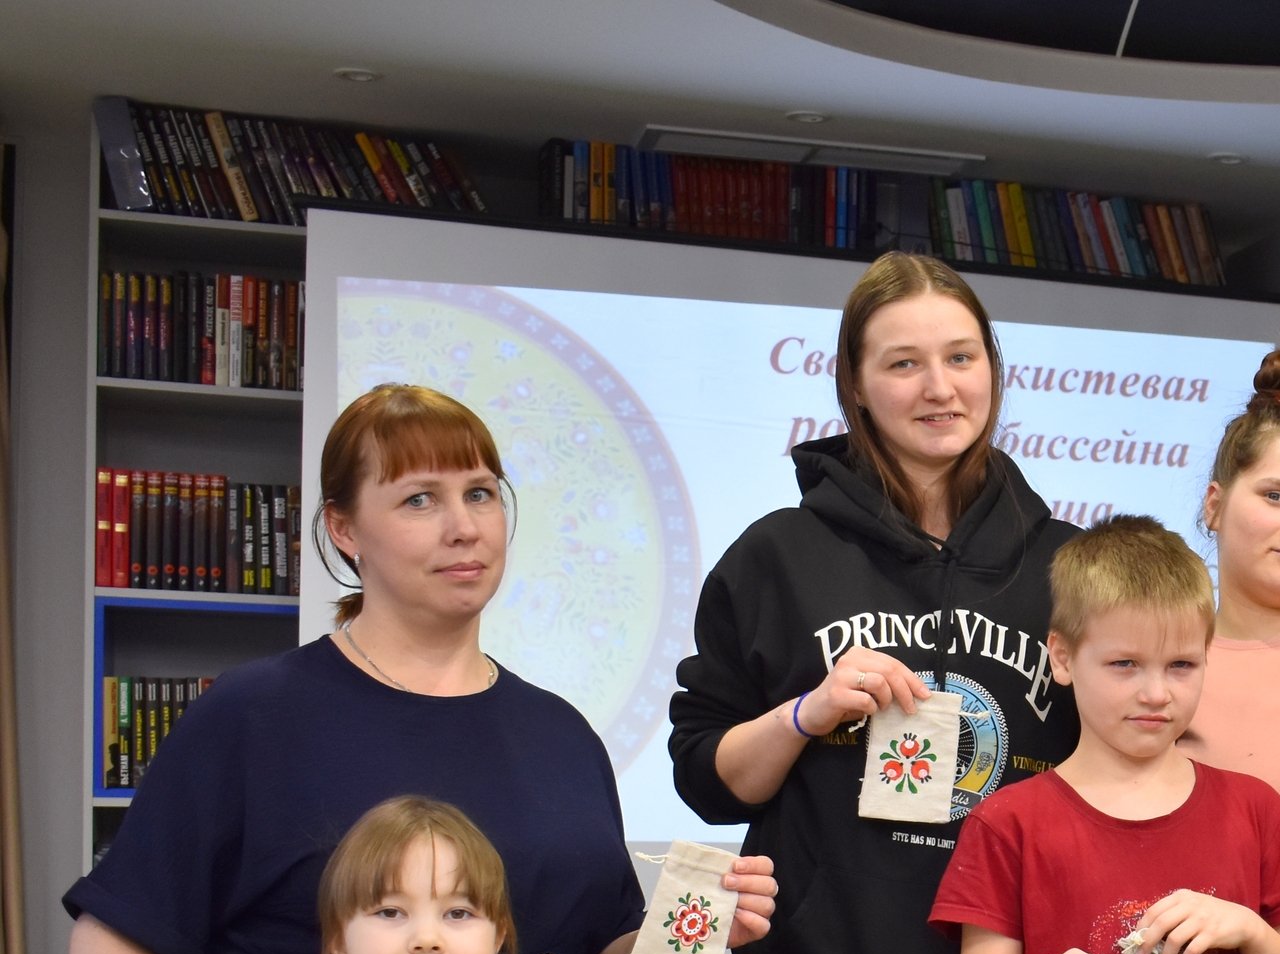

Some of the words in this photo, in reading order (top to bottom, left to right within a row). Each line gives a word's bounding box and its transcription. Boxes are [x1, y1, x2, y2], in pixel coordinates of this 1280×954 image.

[1007, 366, 1210, 402] кистевая
[1000, 423, 1189, 467] бассейна
[120, 755, 129, 785] ВЬЕТНАМ
[911, 834, 925, 845] HAS
[926, 835, 936, 846] NO
